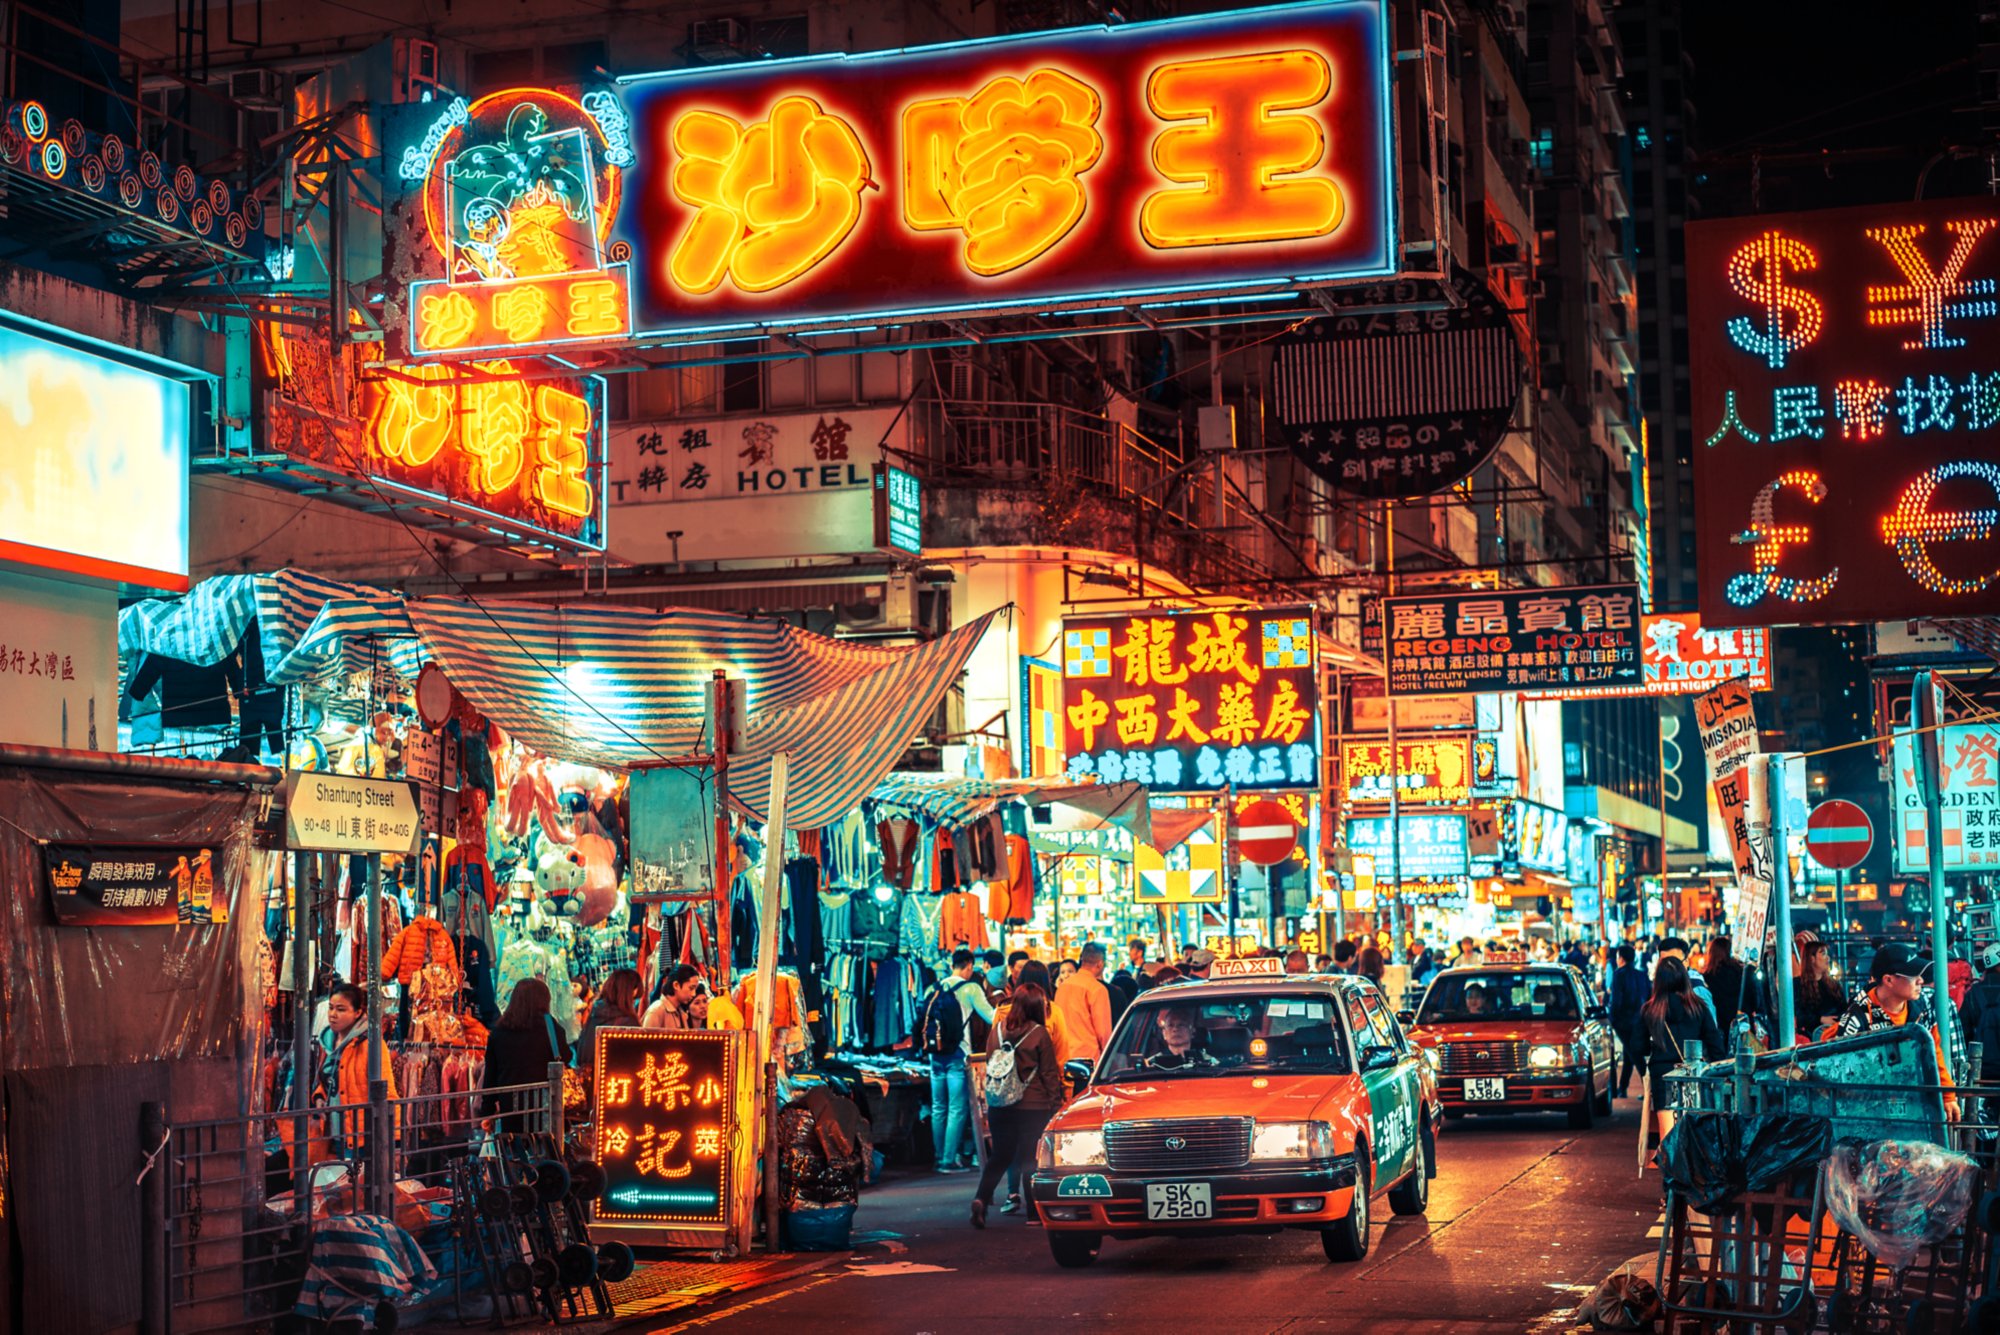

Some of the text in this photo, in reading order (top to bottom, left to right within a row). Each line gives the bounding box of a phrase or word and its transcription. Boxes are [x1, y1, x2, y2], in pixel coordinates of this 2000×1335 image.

[670, 49, 1344, 293] 沙嗲王
[1866, 218, 1998, 350] ¥
[1727, 231, 1823, 369] $
[421, 279, 621, 348] 沙嗲王
[738, 464, 869, 492] HOTEL
[1726, 471, 1839, 606] £
[1880, 459, 2000, 596] €
[1391, 593, 1633, 640] 麗晶賓館
[1113, 614, 1260, 687] 龍城
[1394, 636, 1512, 656] REGENG
[1536, 632, 1631, 650] HOTEL
[1393, 673, 1421, 682] HOTEL
[1424, 671, 1462, 681] FACILITY
[1667, 658, 1766, 681] HOTEL
[1393, 679, 1467, 691] HOTEL FREE WIFI
[1650, 682, 1678, 692] OVER
[1067, 679, 1310, 751] 中西大藥房
[1902, 733, 1999, 788] 登
[316, 783, 394, 808] Shantung Street
[336, 816, 376, 840] 山東街
[1417, 845, 1464, 855] HOTEL
[1216, 959, 1277, 975] TAXI
[1488, 952, 1526, 962] TAXI
[1468, 1088, 1501, 1099] 3386
[1475, 1078, 1493, 1088] EM
[1078, 1177, 1090, 1188] 4
[1166, 1185, 1192, 1200] SK
[1153, 1201, 1206, 1218] 7520
